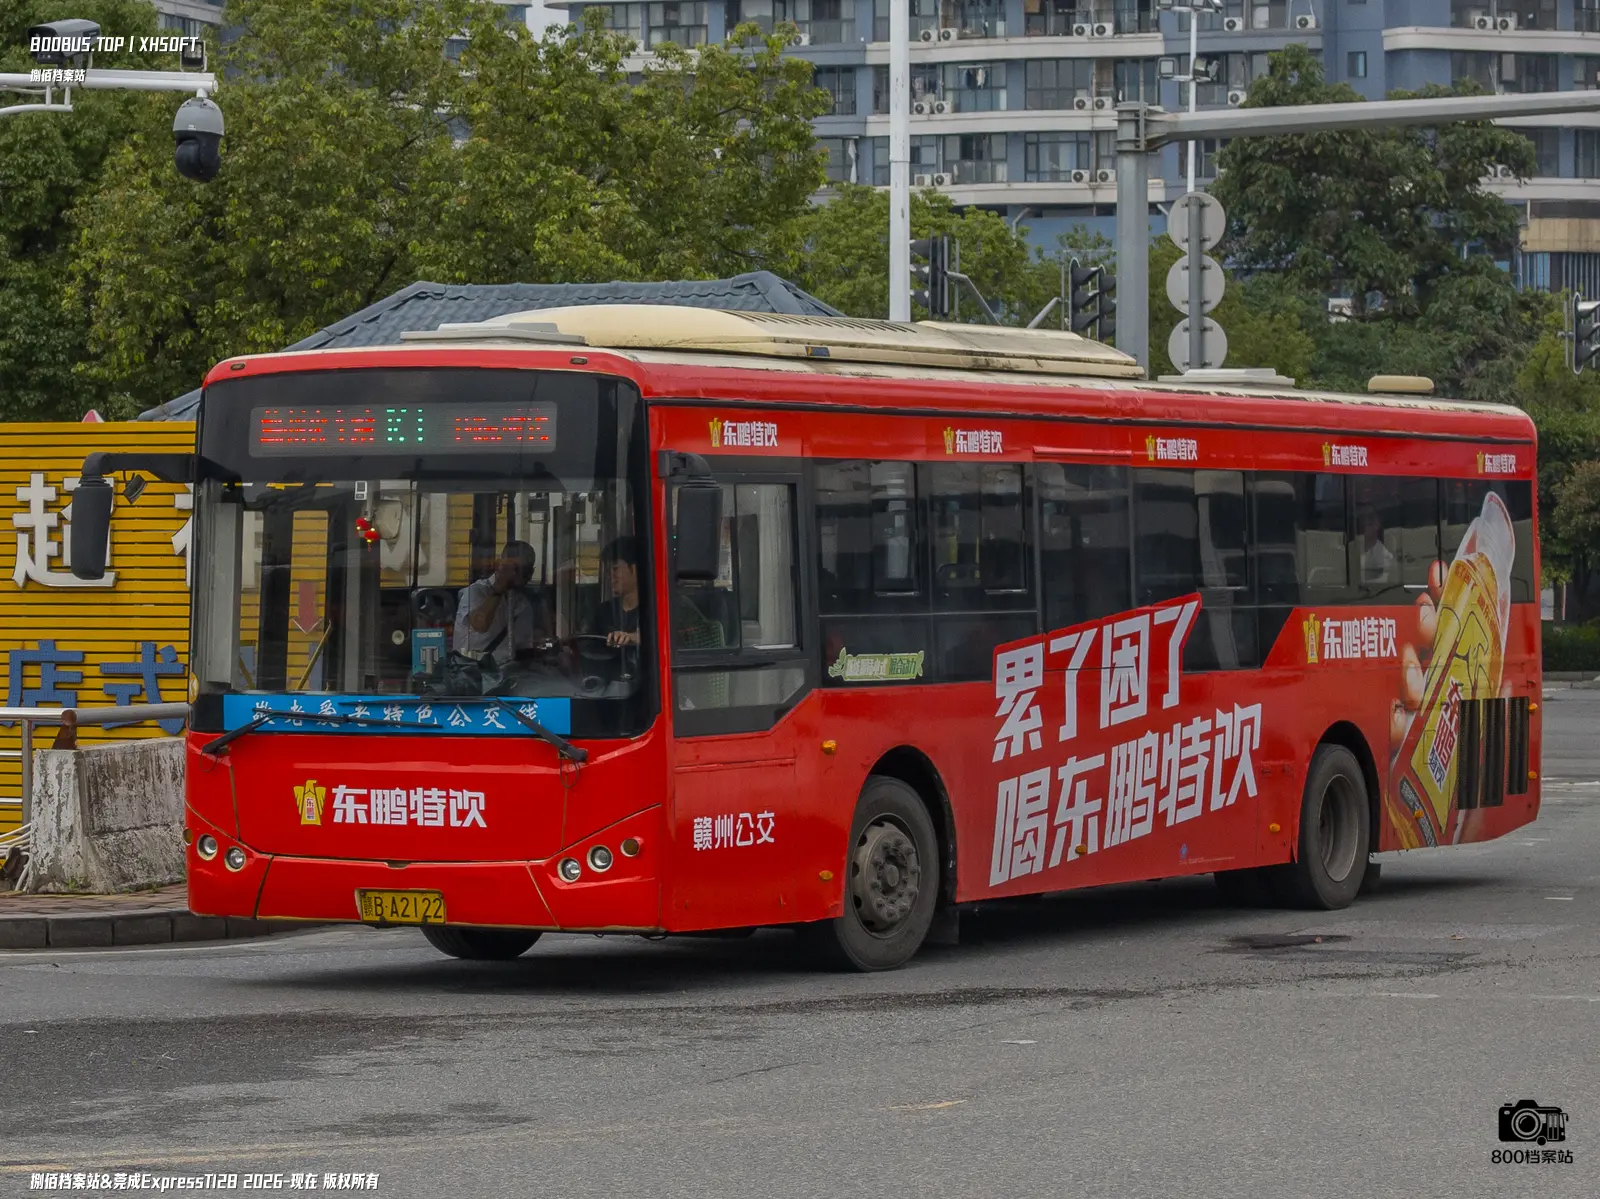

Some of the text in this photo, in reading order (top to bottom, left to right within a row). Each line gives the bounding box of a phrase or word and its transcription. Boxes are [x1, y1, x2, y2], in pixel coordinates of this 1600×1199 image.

[723, 420, 778, 447] 东鹏特饮
[956, 429, 1003, 454] 东鹏特饮
[1323, 616, 1398, 660] 东鹏特饮
[992, 600, 1199, 763] 累了困了
[332, 784, 487, 828] 东鹏特饮
[989, 702, 1262, 887] 喝东鹏特饮
[693, 810, 775, 851] 赣州公交
